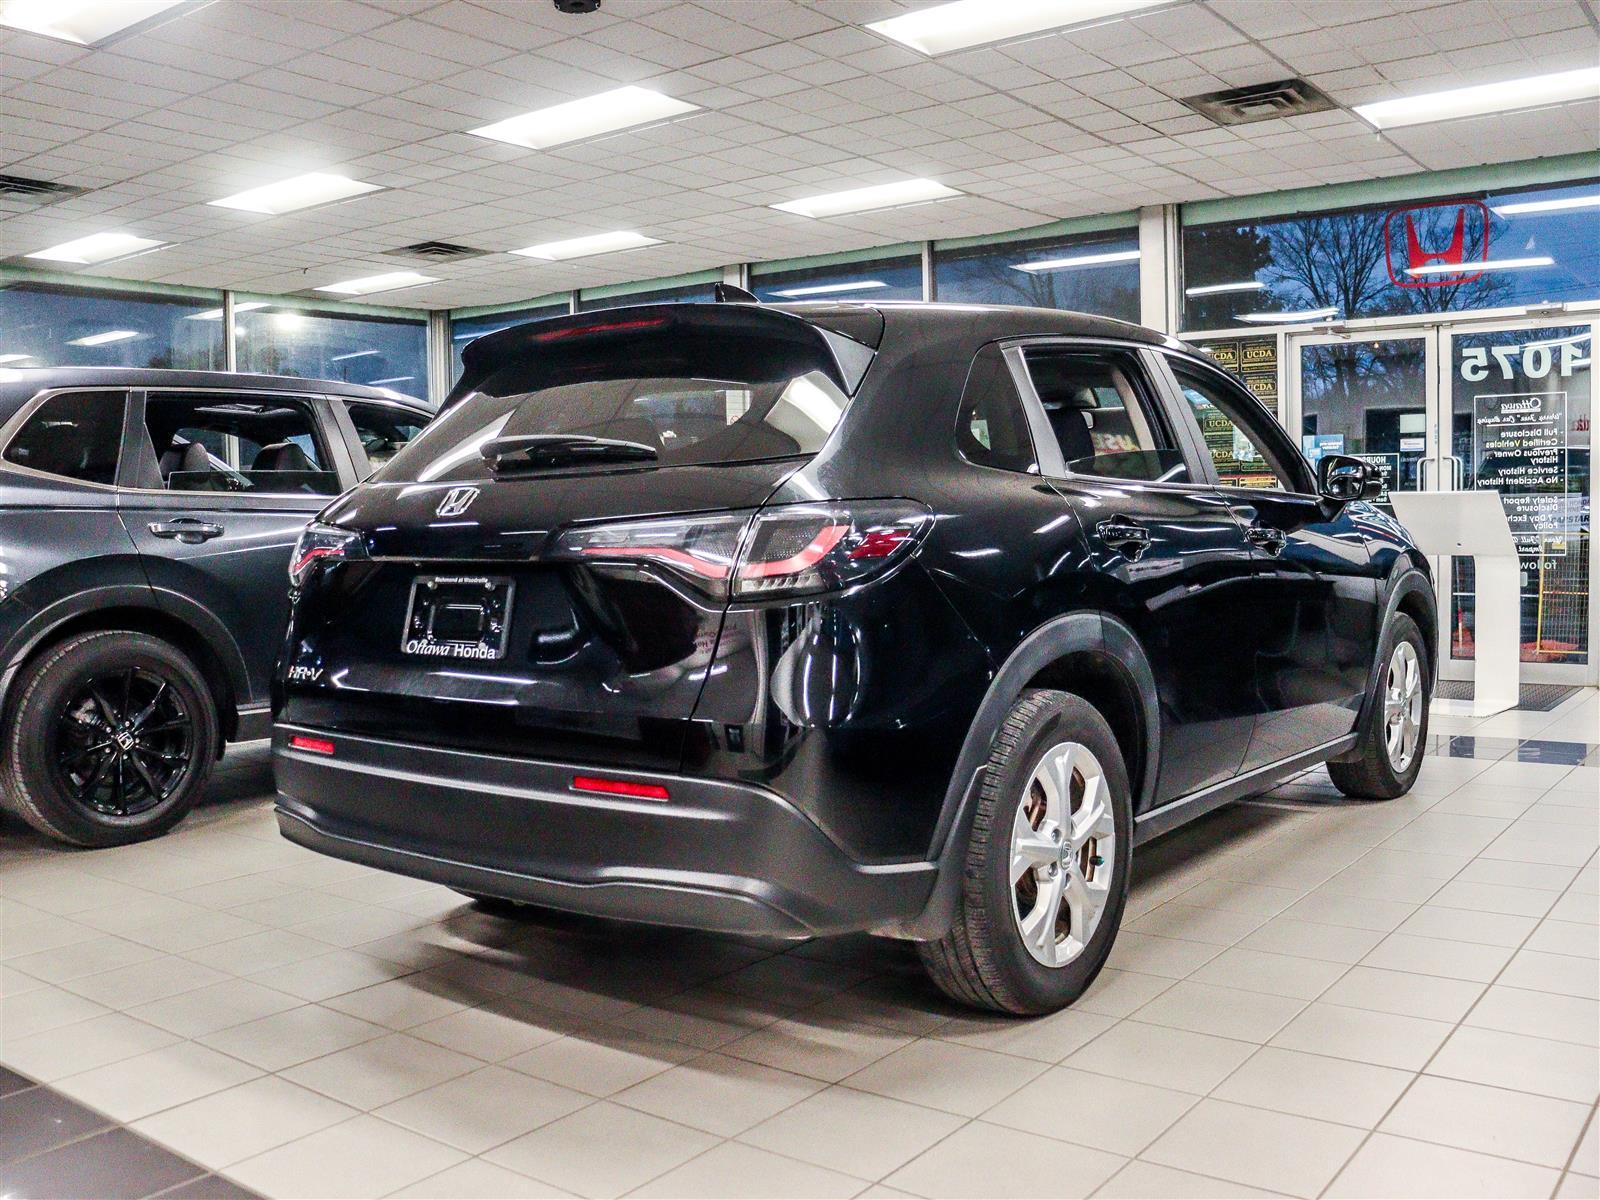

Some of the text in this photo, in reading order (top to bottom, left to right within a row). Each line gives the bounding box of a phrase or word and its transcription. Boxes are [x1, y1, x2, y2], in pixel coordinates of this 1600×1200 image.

[1247, 350, 1272, 358] UCDA
[1209, 420, 1233, 428] UCDA
[406, 639, 496, 660] Ottawa Honda
